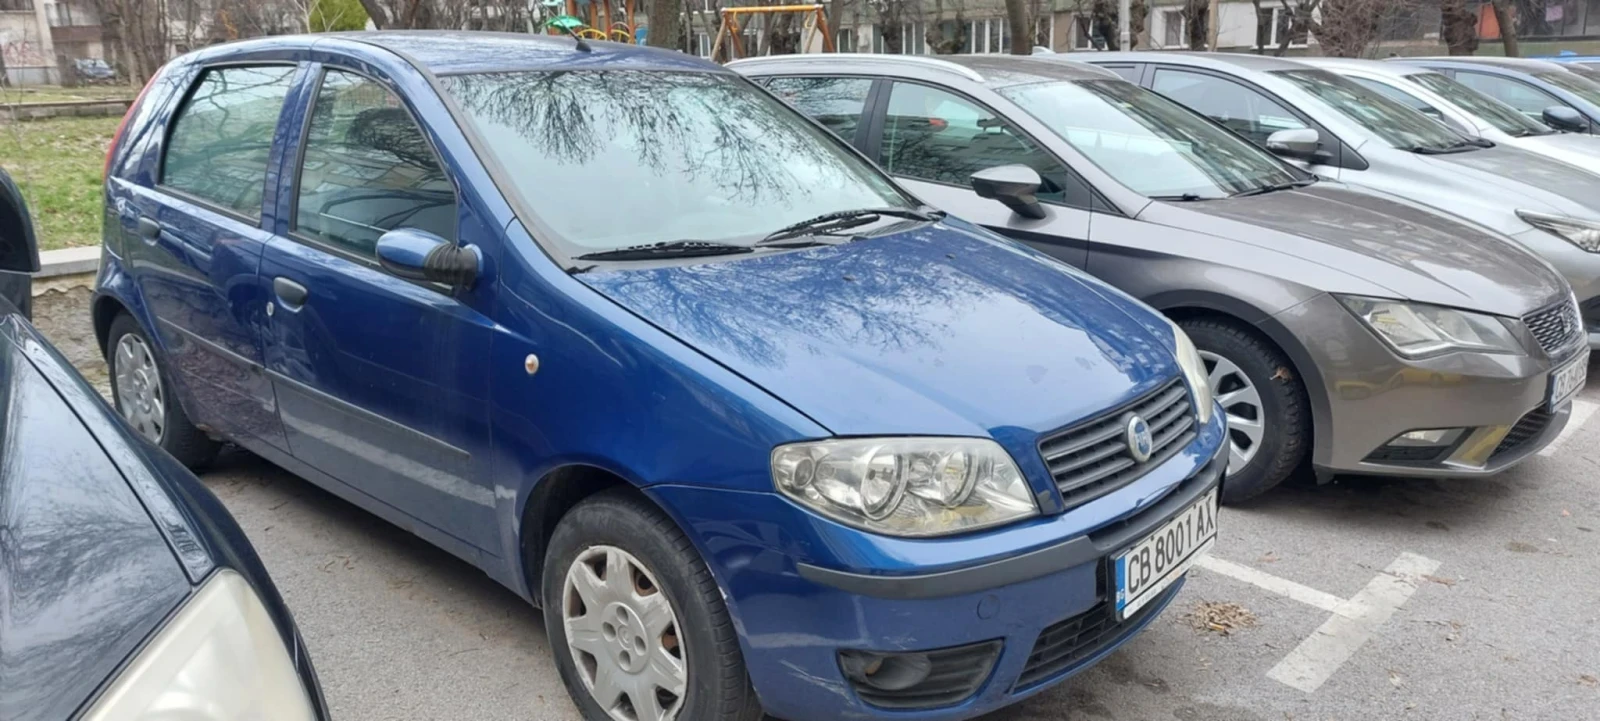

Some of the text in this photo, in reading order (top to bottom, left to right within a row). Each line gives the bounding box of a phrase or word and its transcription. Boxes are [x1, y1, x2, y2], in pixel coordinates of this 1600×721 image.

[1128, 546, 1151, 594] CB
[1155, 514, 1192, 574] 8001
[1196, 496, 1214, 541] AX
